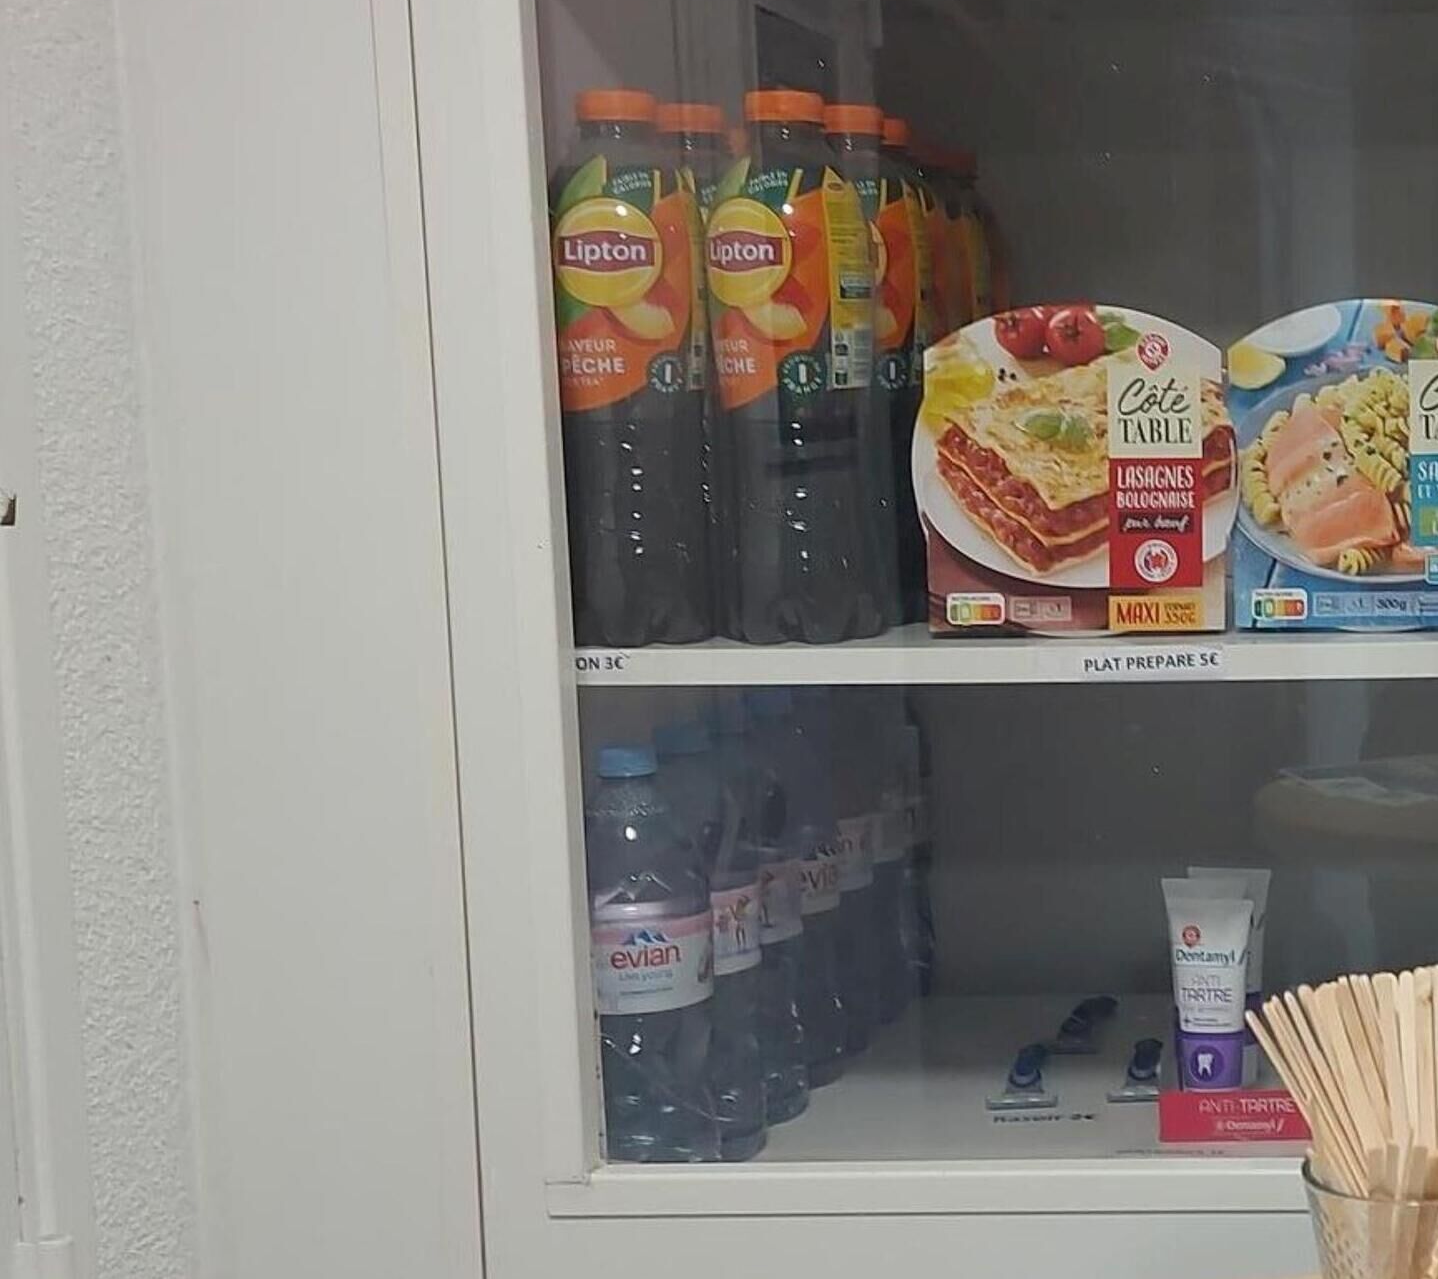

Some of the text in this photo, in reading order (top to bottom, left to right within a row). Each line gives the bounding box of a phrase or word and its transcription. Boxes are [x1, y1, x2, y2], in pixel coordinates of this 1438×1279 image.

[564, 240, 646, 264] Lipton
[709, 239, 775, 264] Lipton
[1118, 377, 1190, 416] Côté
[1118, 419, 1193, 445] TABLE
[1117, 465, 1194, 489] LASAGNES
[1116, 490, 1195, 509] BOLOGNAISE
[1117, 603, 1160, 625] MAXI
[604, 656, 624, 671] 3€
[1084, 652, 1220, 673] PLAT PREPARE 5€
[610, 944, 681, 969] evian
[1181, 987, 1233, 1002] TARTRE
